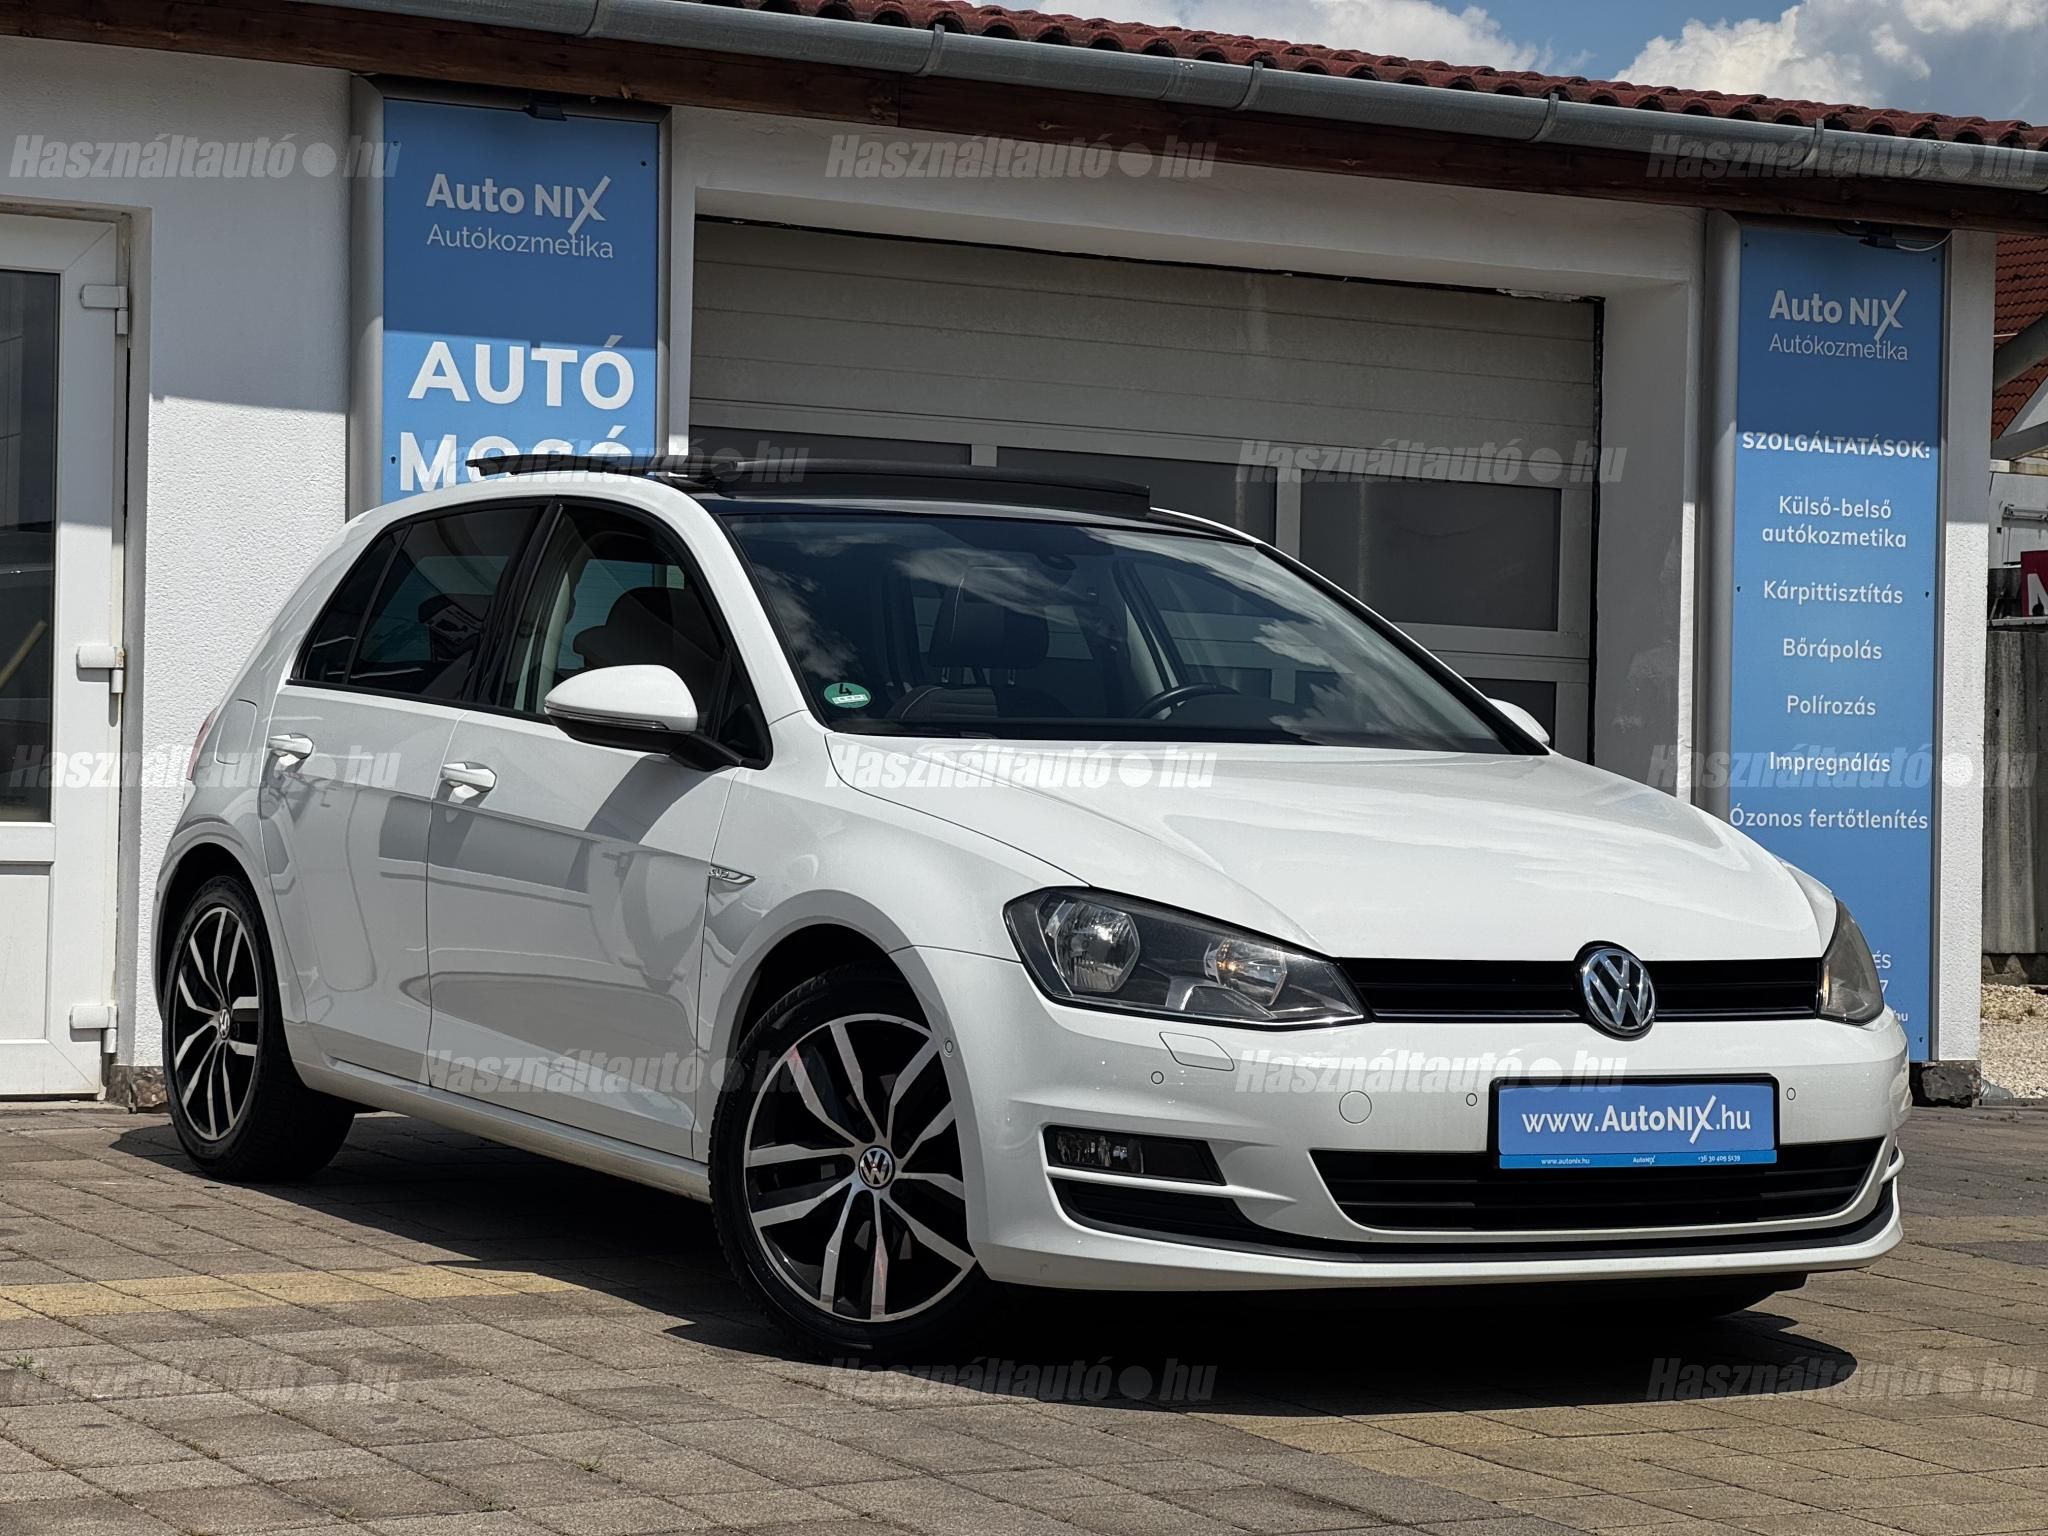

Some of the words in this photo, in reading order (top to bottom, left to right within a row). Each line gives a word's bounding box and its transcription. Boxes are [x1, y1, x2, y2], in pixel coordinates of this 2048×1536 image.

[426, 172, 524, 214] Auto
[534, 176, 611, 235] NIX
[426, 223, 614, 260] Autókozmetika
[1769, 289, 1843, 324] Auto
[1849, 289, 1908, 340] NIX
[1768, 333, 1909, 361] Autókozmetika
[407, 334, 635, 411] AUTÓ
[1741, 430, 1932, 460] SZOLGÁLTATÁSOK:
[1778, 496, 1893, 520] Külső-belső
[1761, 525, 1907, 549] autókozmetika
[1763, 580, 1904, 606] Kárpittisztítás
[1782, 637, 1883, 661] Bőrápolás
[1786, 694, 1877, 717] Polírozás
[1769, 751, 1891, 775] Impregnálás
[1729, 804, 1803, 827] Ózonos
[1808, 808, 1929, 831] fertőtlenítés
